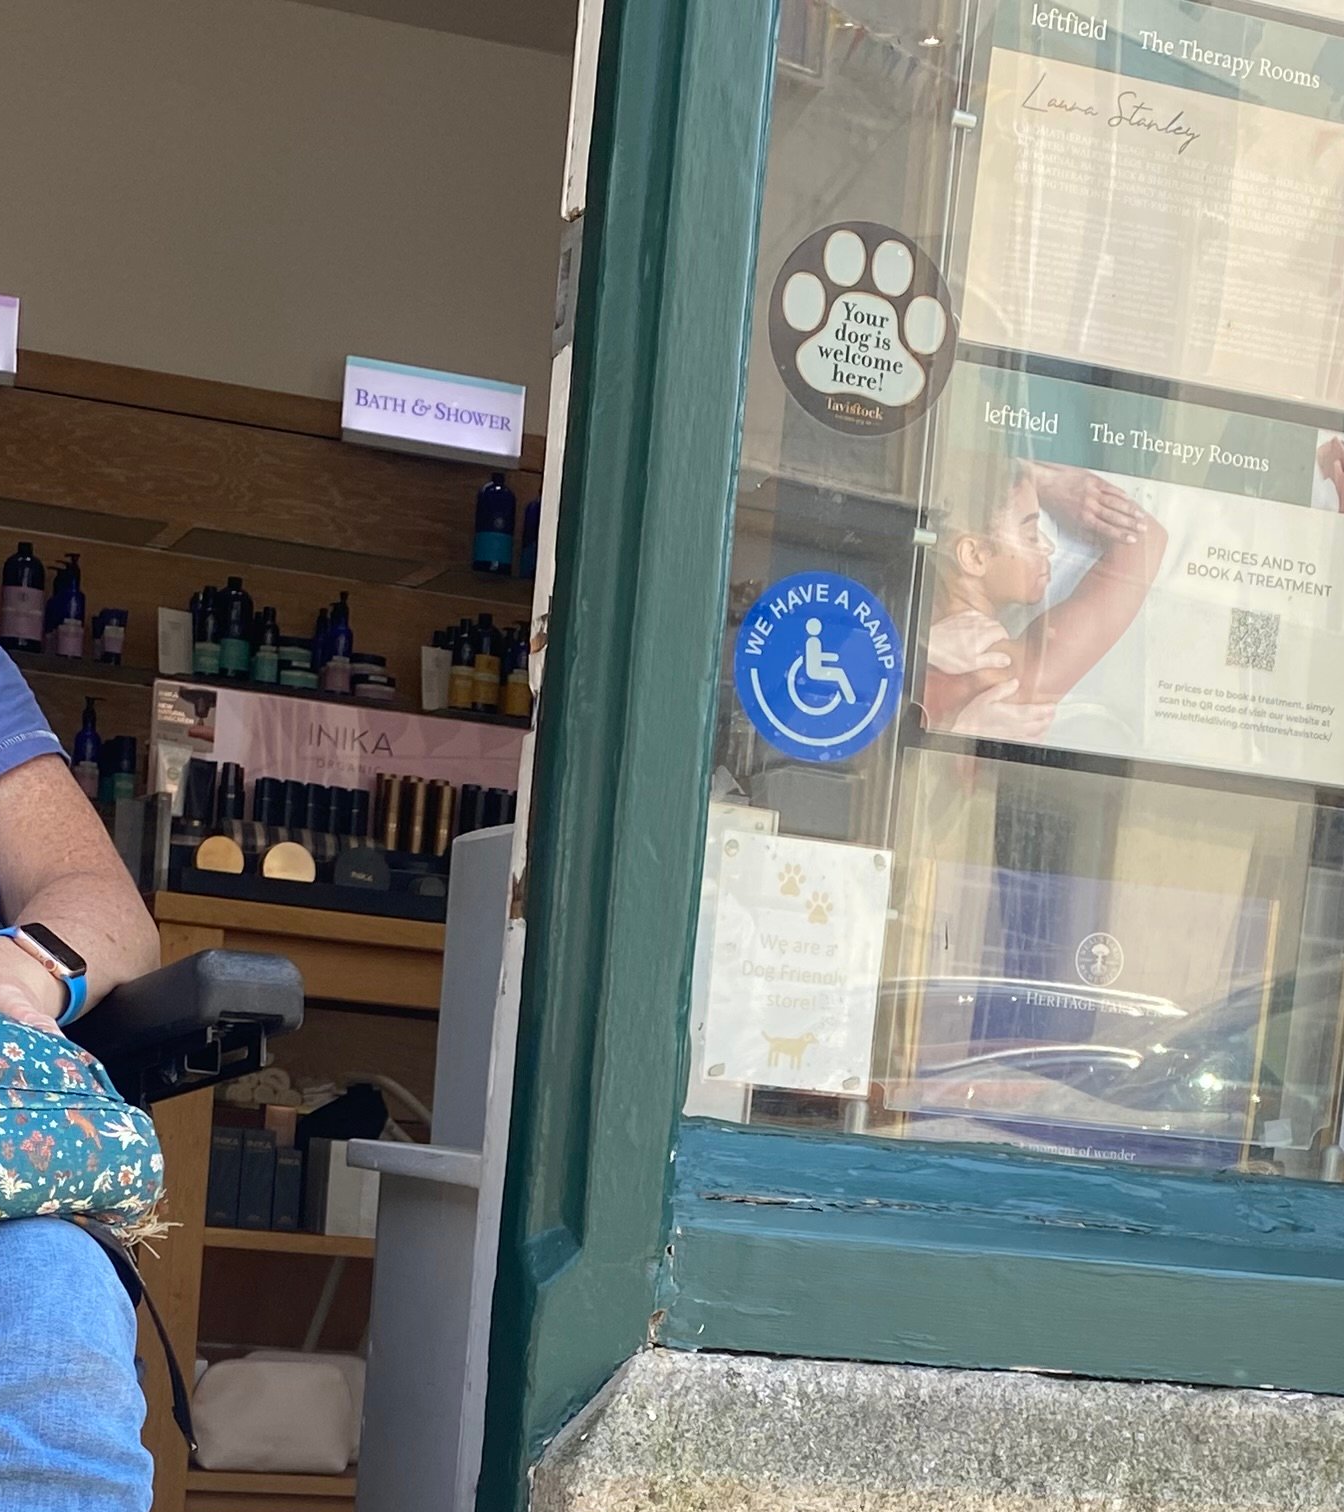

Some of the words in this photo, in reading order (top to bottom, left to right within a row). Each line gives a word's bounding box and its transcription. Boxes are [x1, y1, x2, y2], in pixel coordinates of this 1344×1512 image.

[1031, 4, 1107, 41] leftfield
[1139, 30, 1174, 55] The
[1179, 39, 1255, 79] Therapy
[1258, 58, 1321, 89] Rooms
[1107, 91, 1201, 155] Stanley
[842, 300, 890, 329] Your
[835, 322, 872, 353] dog
[875, 330, 892, 351] is
[817, 344, 904, 375] welcome
[831, 363, 885, 392] here!
[356, 388, 406, 413] BATH
[412, 398, 431, 416] &
[434, 402, 512, 432] SHOWER
[984, 401, 1059, 435] leftfield
[1090, 422, 1125, 446] The
[1130, 430, 1205, 465] Therapy
[1209, 444, 1270, 472] Rooms
[1207, 546, 1258, 566] PRICES
[1261, 555, 1294, 572] AND
[1297, 560, 1317, 576] TO
[1187, 562, 1232, 581] BOOK
[1233, 570, 1244, 583] A
[1247, 572, 1333, 597] TREATMENT
[745, 616, 774, 656] WE
[769, 583, 829, 620] HAVE
[834, 590, 851, 610] A
[853, 601, 895, 670] RAMP
[1158, 679, 1173, 691] For
[1174, 682, 1202, 696] prices
[1203, 687, 1214, 696] or
[1215, 687, 1225, 698] to
[1226, 689, 1249, 702] book
[1305, 702, 1335, 716] simply
[1158, 695, 1180, 706] scan
[1181, 697, 1197, 708] the
[1199, 699, 1213, 712] QR
[1214, 702, 1236, 714] code
[1269, 710, 1284, 721] our
[1285, 712, 1320, 727] website
[1321, 717, 1331, 728] at
[309, 723, 394, 757] INIKA
[760, 933, 788, 951] We
[793, 942, 820, 955] are
[825, 945, 835, 957] a
[741, 960, 775, 982] Dog
[780, 964, 848, 987] Friendly
[1026, 991, 1096, 1012] HERITAGE
[1080, 1145, 1092, 1157] of
[1094, 1148, 1136, 1161] wonder
